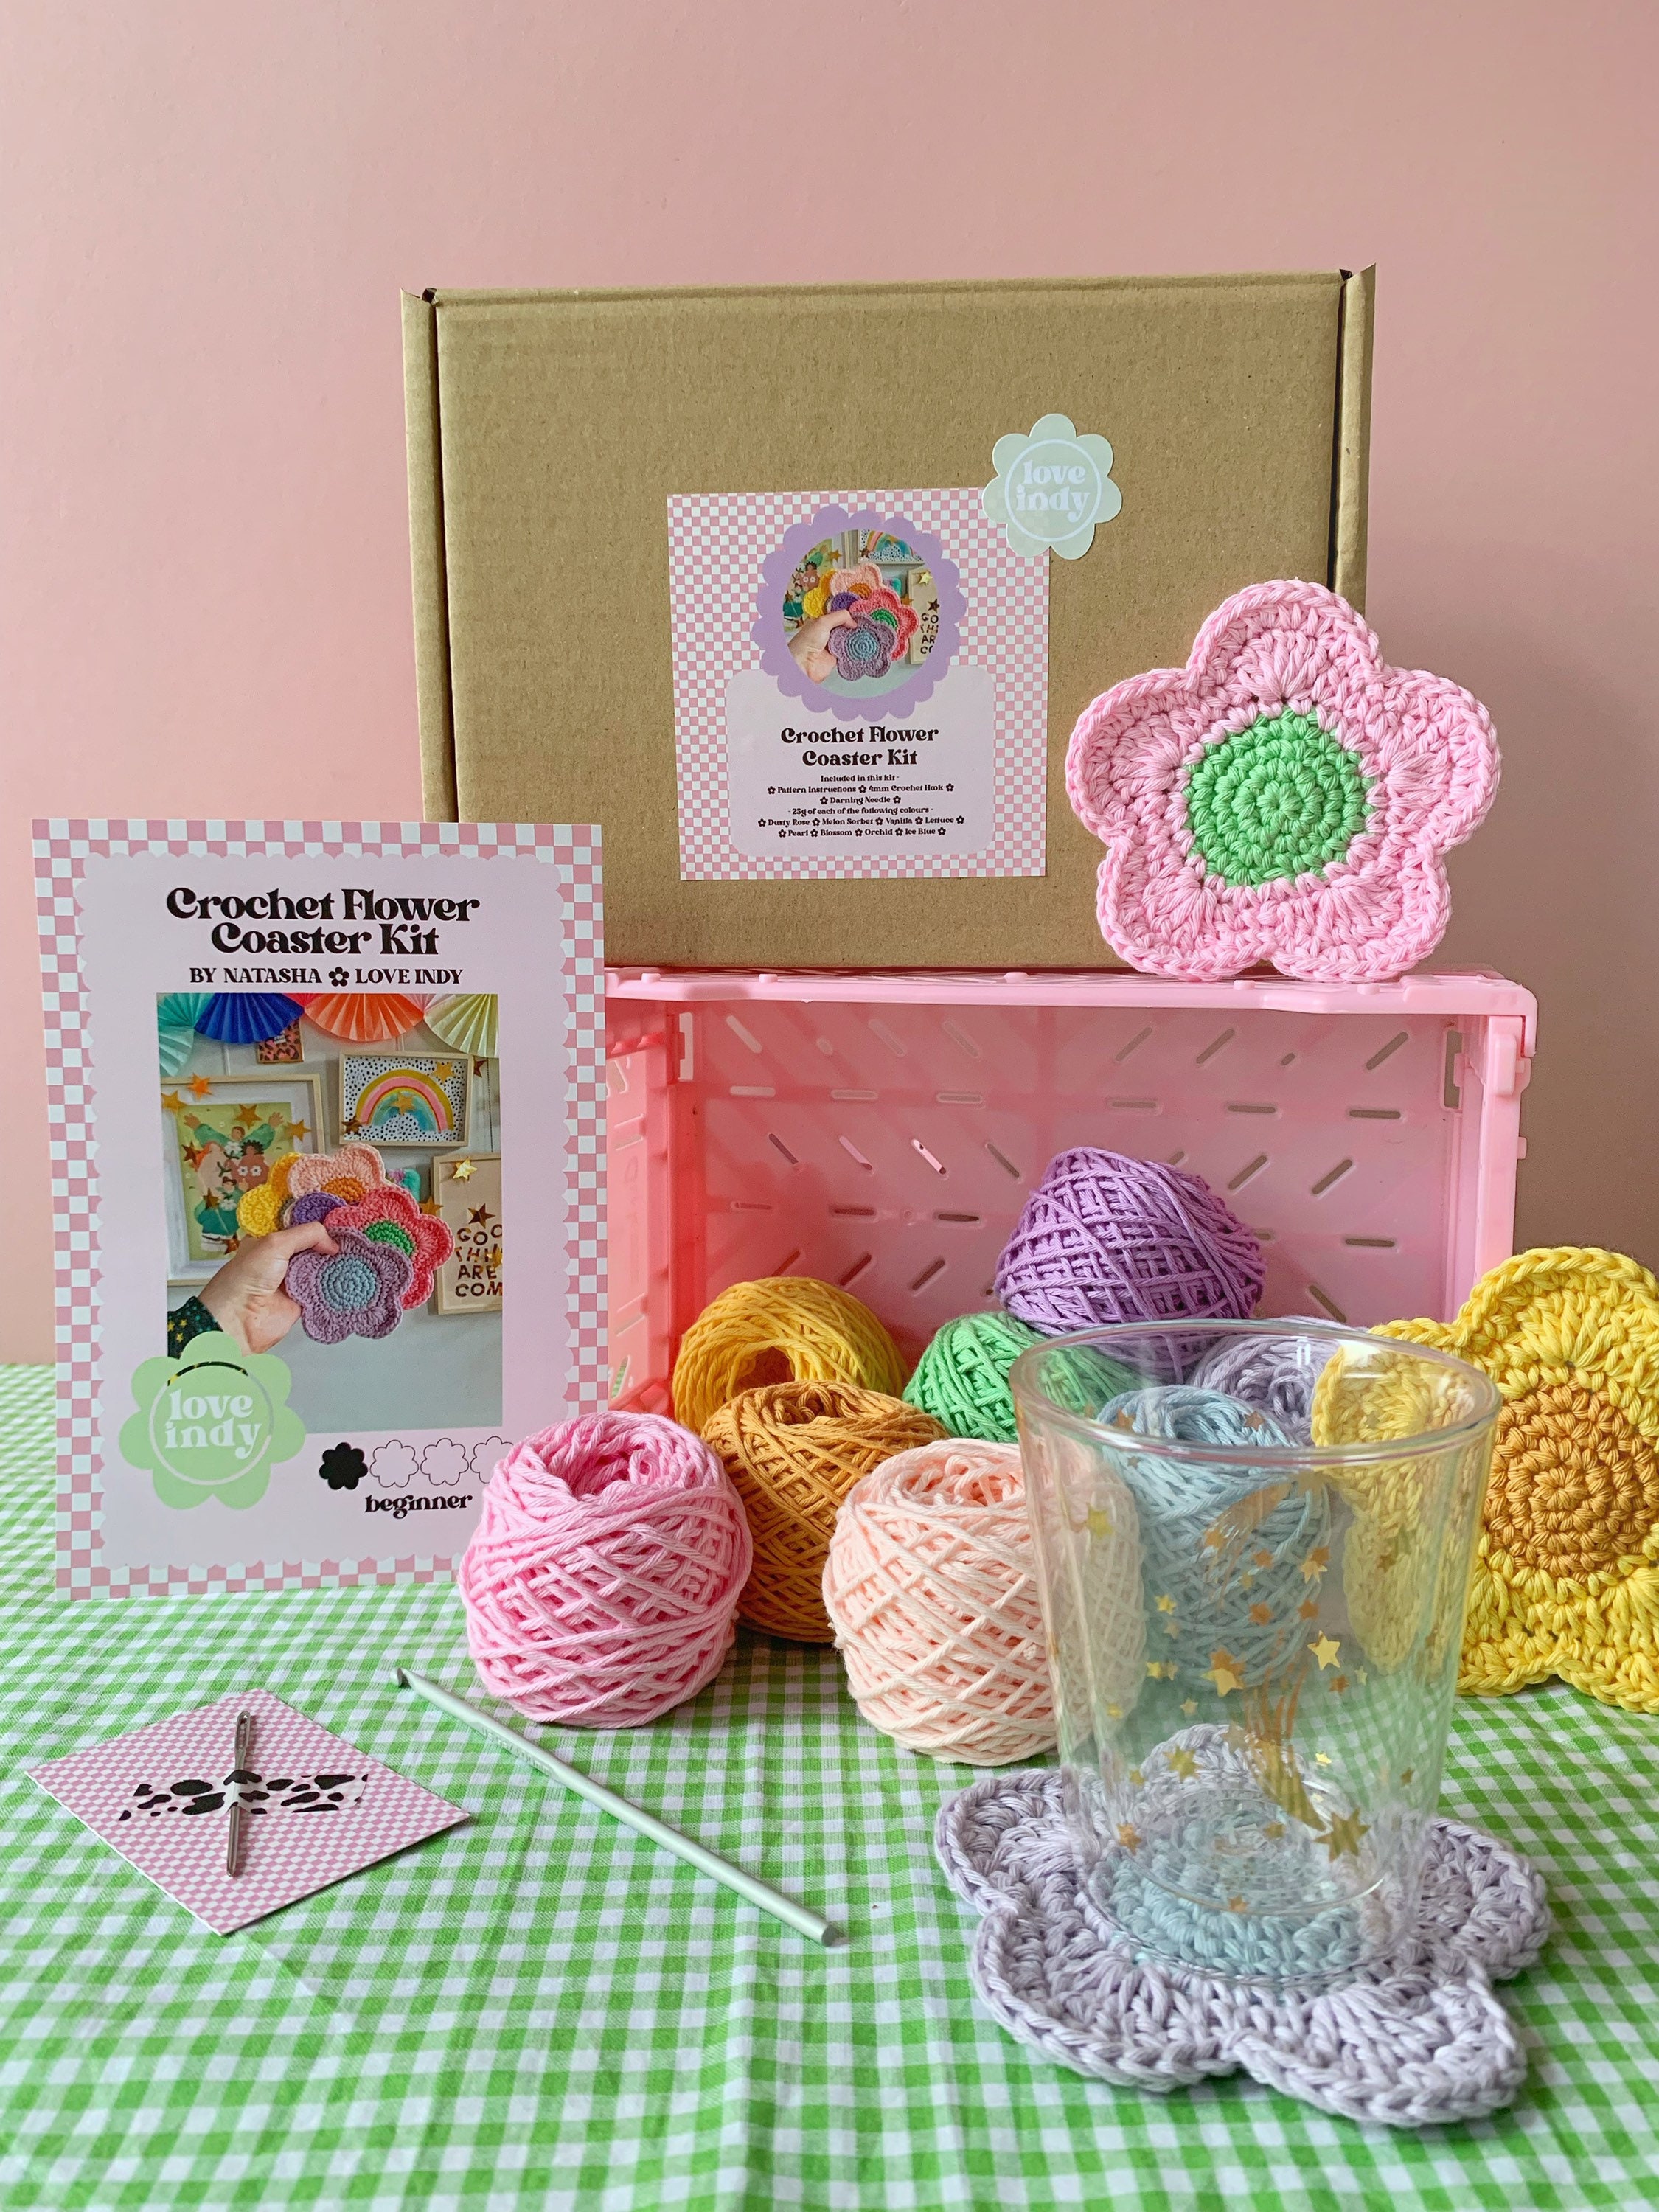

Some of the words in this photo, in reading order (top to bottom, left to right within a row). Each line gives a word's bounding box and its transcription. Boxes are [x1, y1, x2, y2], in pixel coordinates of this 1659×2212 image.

[1023, 460, 1085, 484] love
[1016, 484, 1090, 523] indy
[781, 727, 864, 743] Crochet
[869, 726, 939, 742] Flower
[802, 749, 883, 766] Coaster
[888, 749, 917, 765] Kit
[830, 796, 863, 805] Darning
[792, 808, 807, 817] 25g
[861, 807, 898, 815] following
[768, 819, 790, 828] Dusty
[886, 817, 912, 825] Vanilla
[167, 888, 335, 921] Crochet
[341, 888, 480, 922] Flower
[212, 922, 372, 955] Coaster
[380, 923, 439, 956] Kit
[189, 967, 217, 984] BY
[223, 967, 322, 984] NATASHA
[355, 968, 411, 984] LOVE
[414, 968, 463, 984] INDY
[458, 1265, 497, 1280] ARE
[169, 1388, 254, 1421] love
[164, 1417, 262, 1460] indy
[364, 1495, 473, 1520] beginner
